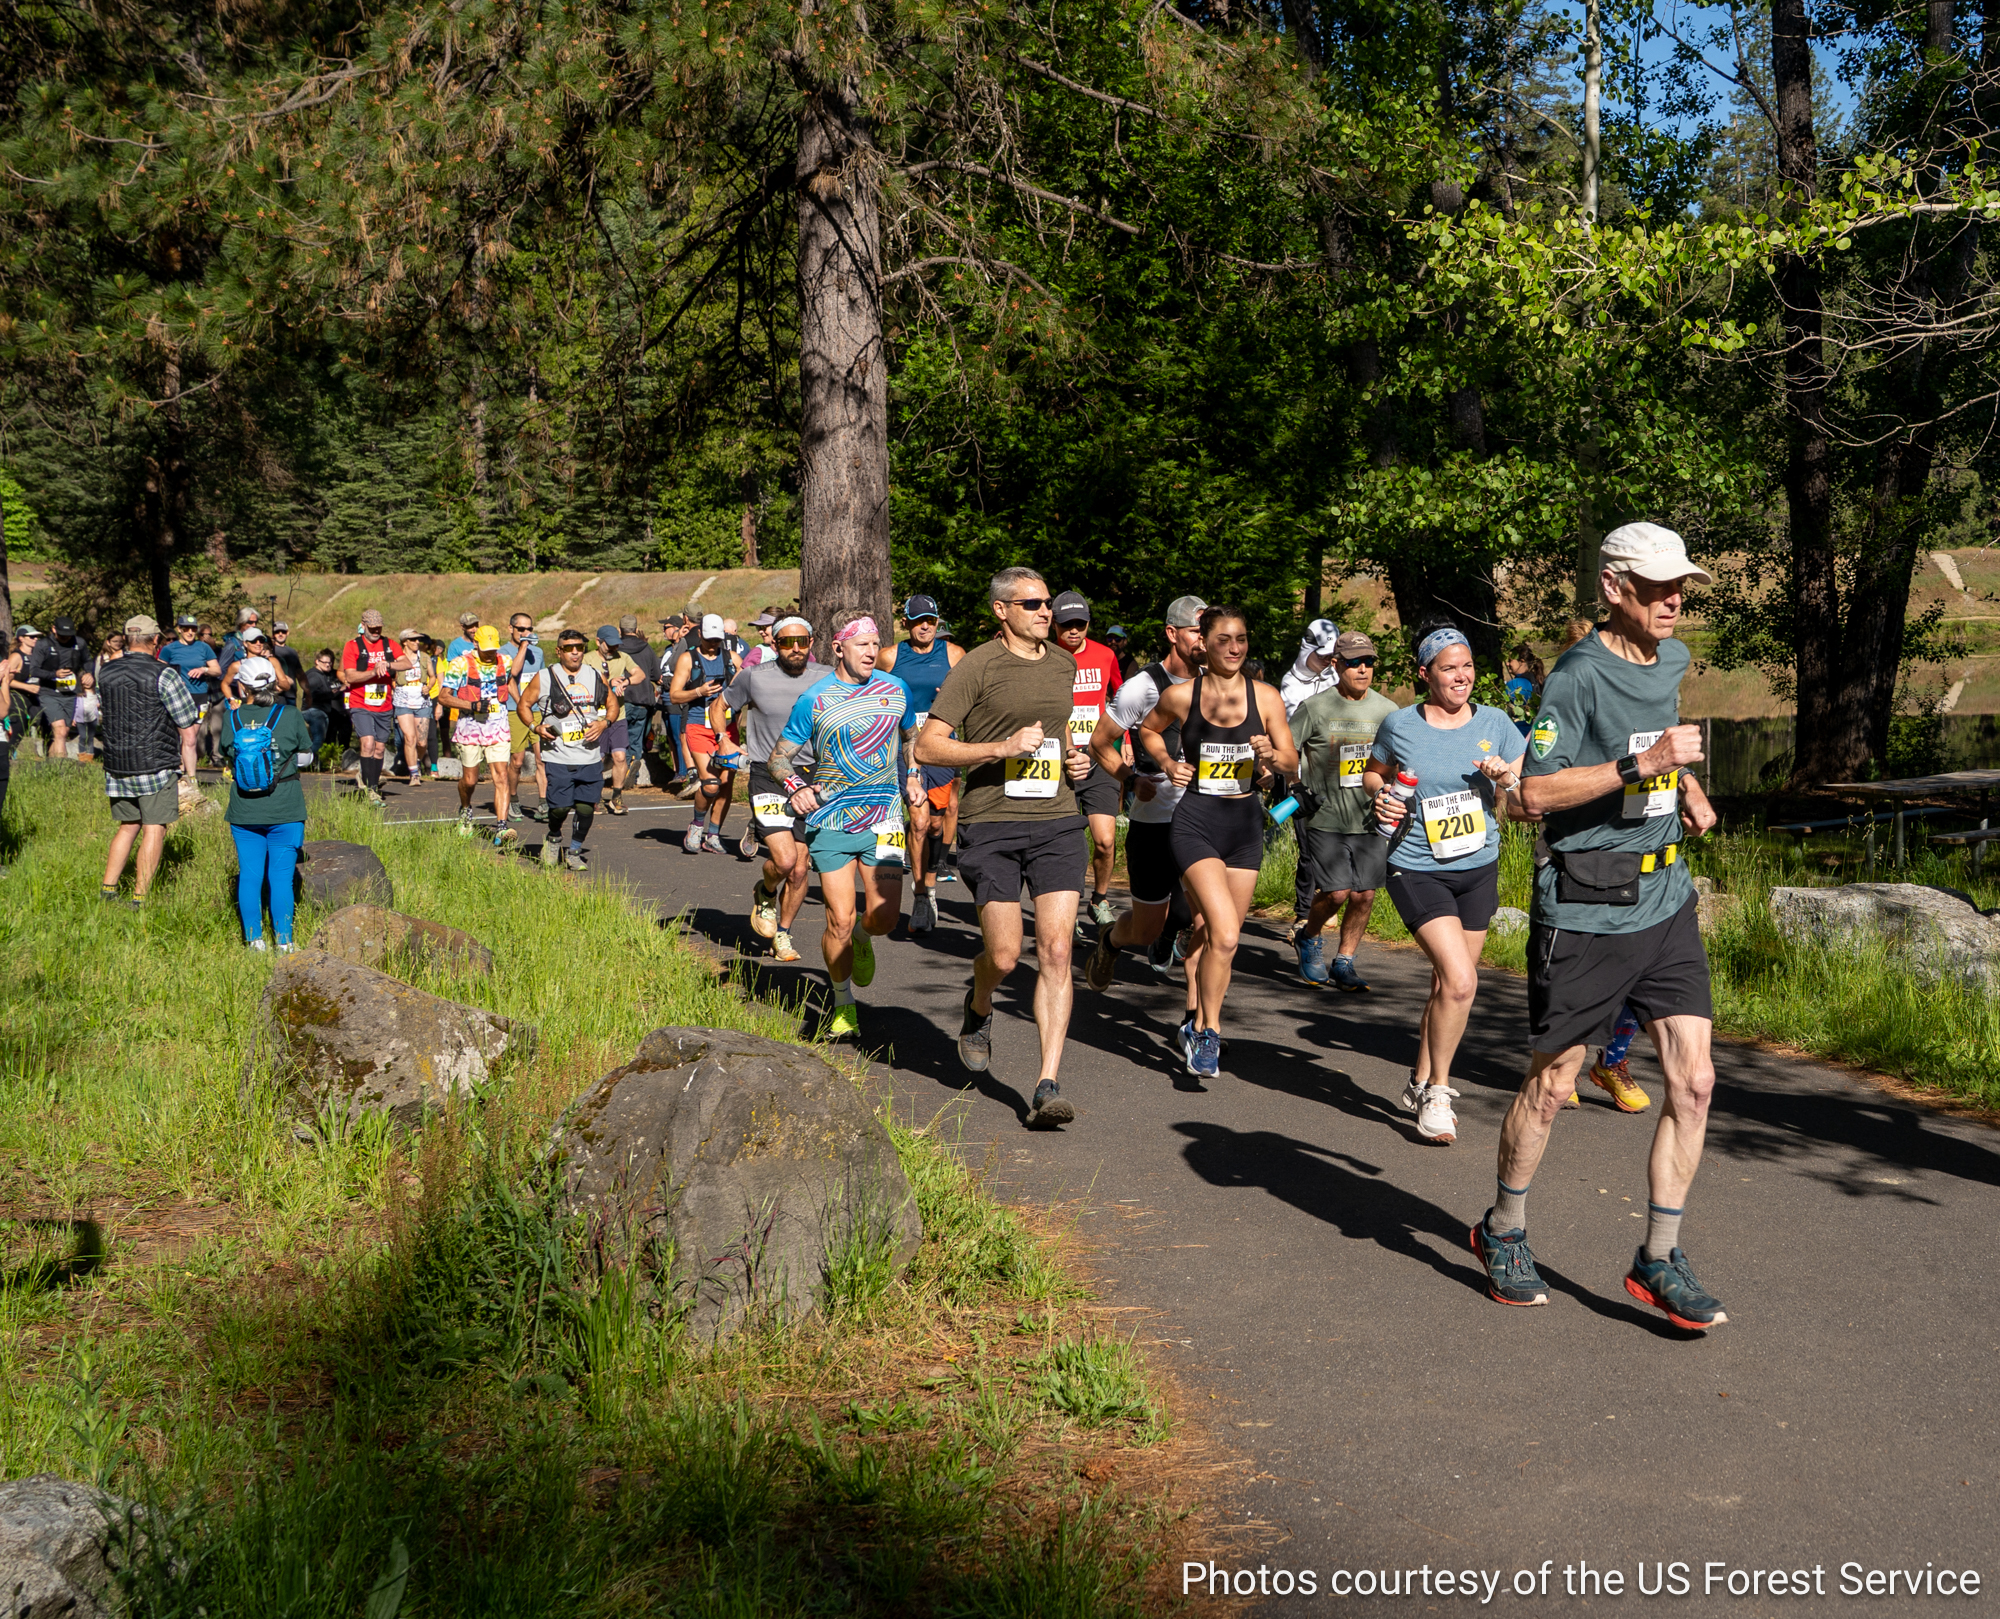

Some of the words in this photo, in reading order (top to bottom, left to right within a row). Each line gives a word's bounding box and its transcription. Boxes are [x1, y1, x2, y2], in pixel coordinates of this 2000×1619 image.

[1074, 668, 1102, 684] ONSIN
[1070, 720, 1093, 733] 246
[569, 730, 584, 741] 23
[1635, 735, 1652, 749] RUN
[1043, 740, 1055, 749] RIM
[1206, 744, 1220, 753] RUN
[1222, 745, 1235, 754] THE
[1236, 745, 1250, 754] RIM
[1343, 745, 1355, 754] RUN
[1355, 744, 1366, 752] THE
[1220, 754, 1235, 762] 21K
[1355, 751, 1366, 759] 21K
[1016, 758, 1051, 780] 228
[1209, 762, 1244, 779] 227
[1347, 759, 1368, 775] 23
[1428, 798, 1445, 810] RUN
[1445, 794, 1459, 806] THE
[1459, 791, 1475, 803] RIM
[1446, 804, 1461, 816] 21K
[1437, 812, 1476, 841] 220
